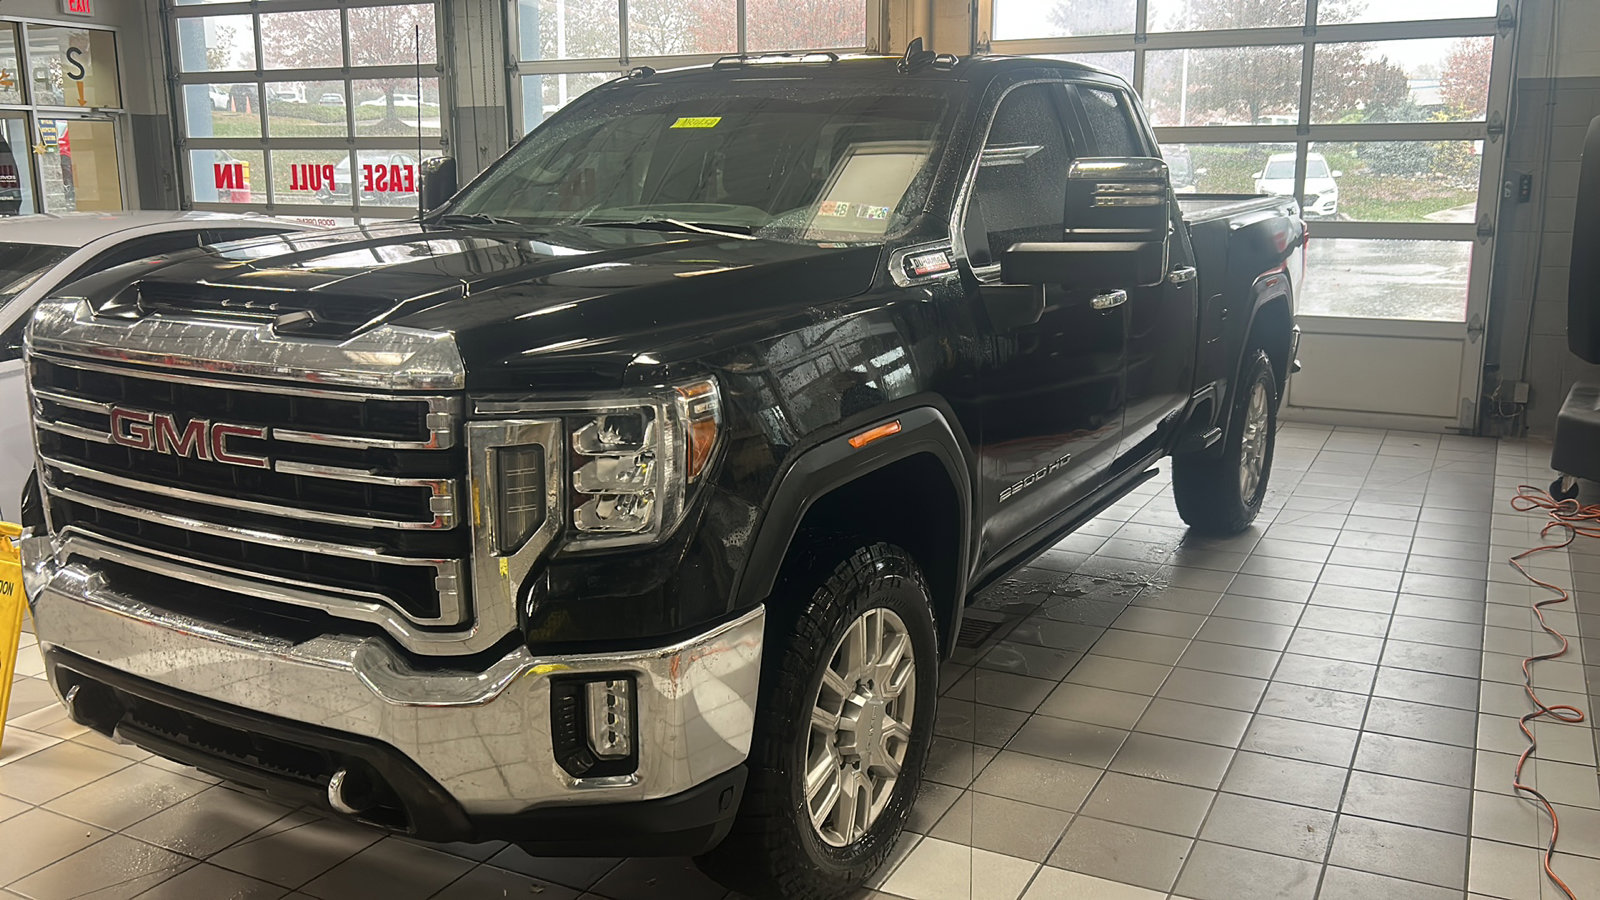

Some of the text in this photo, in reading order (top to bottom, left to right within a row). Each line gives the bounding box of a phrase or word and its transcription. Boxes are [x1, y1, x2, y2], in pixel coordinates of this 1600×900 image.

[110, 406, 271, 470] GMC
[999, 453, 1071, 503] 2500 HD
